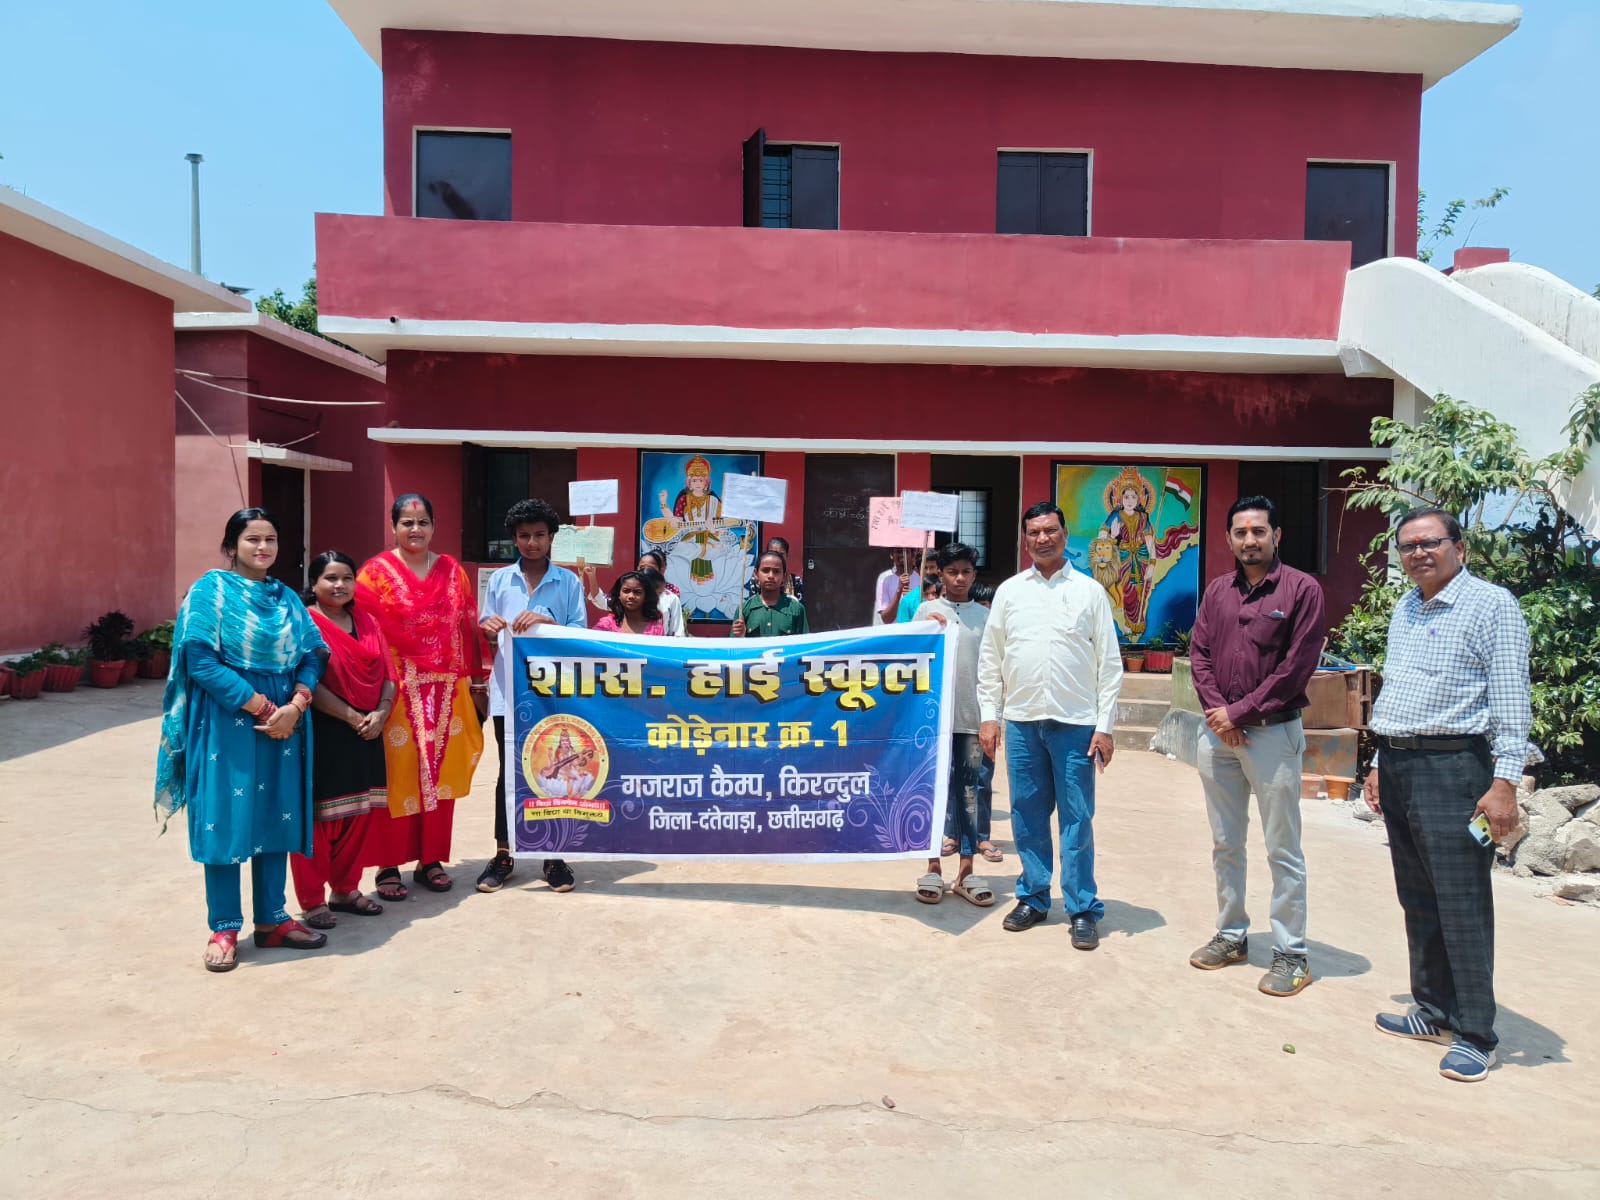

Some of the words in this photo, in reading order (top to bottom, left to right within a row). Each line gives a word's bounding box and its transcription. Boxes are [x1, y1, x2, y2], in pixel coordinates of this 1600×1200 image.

[526, 656, 666, 697] शास.
[684, 648, 785, 703] हाई
[799, 652, 936, 711] स्कूल
[646, 714, 770, 756] कोड़ेनार
[778, 721, 825, 750] क्र.
[831, 720, 848, 747] 1
[620, 774, 704, 798] गजराज
[709, 764, 772, 801] कैम्प,
[779, 765, 871, 802] किरन्दुल
[767, 804, 845, 832] छत्तीसगढ़
